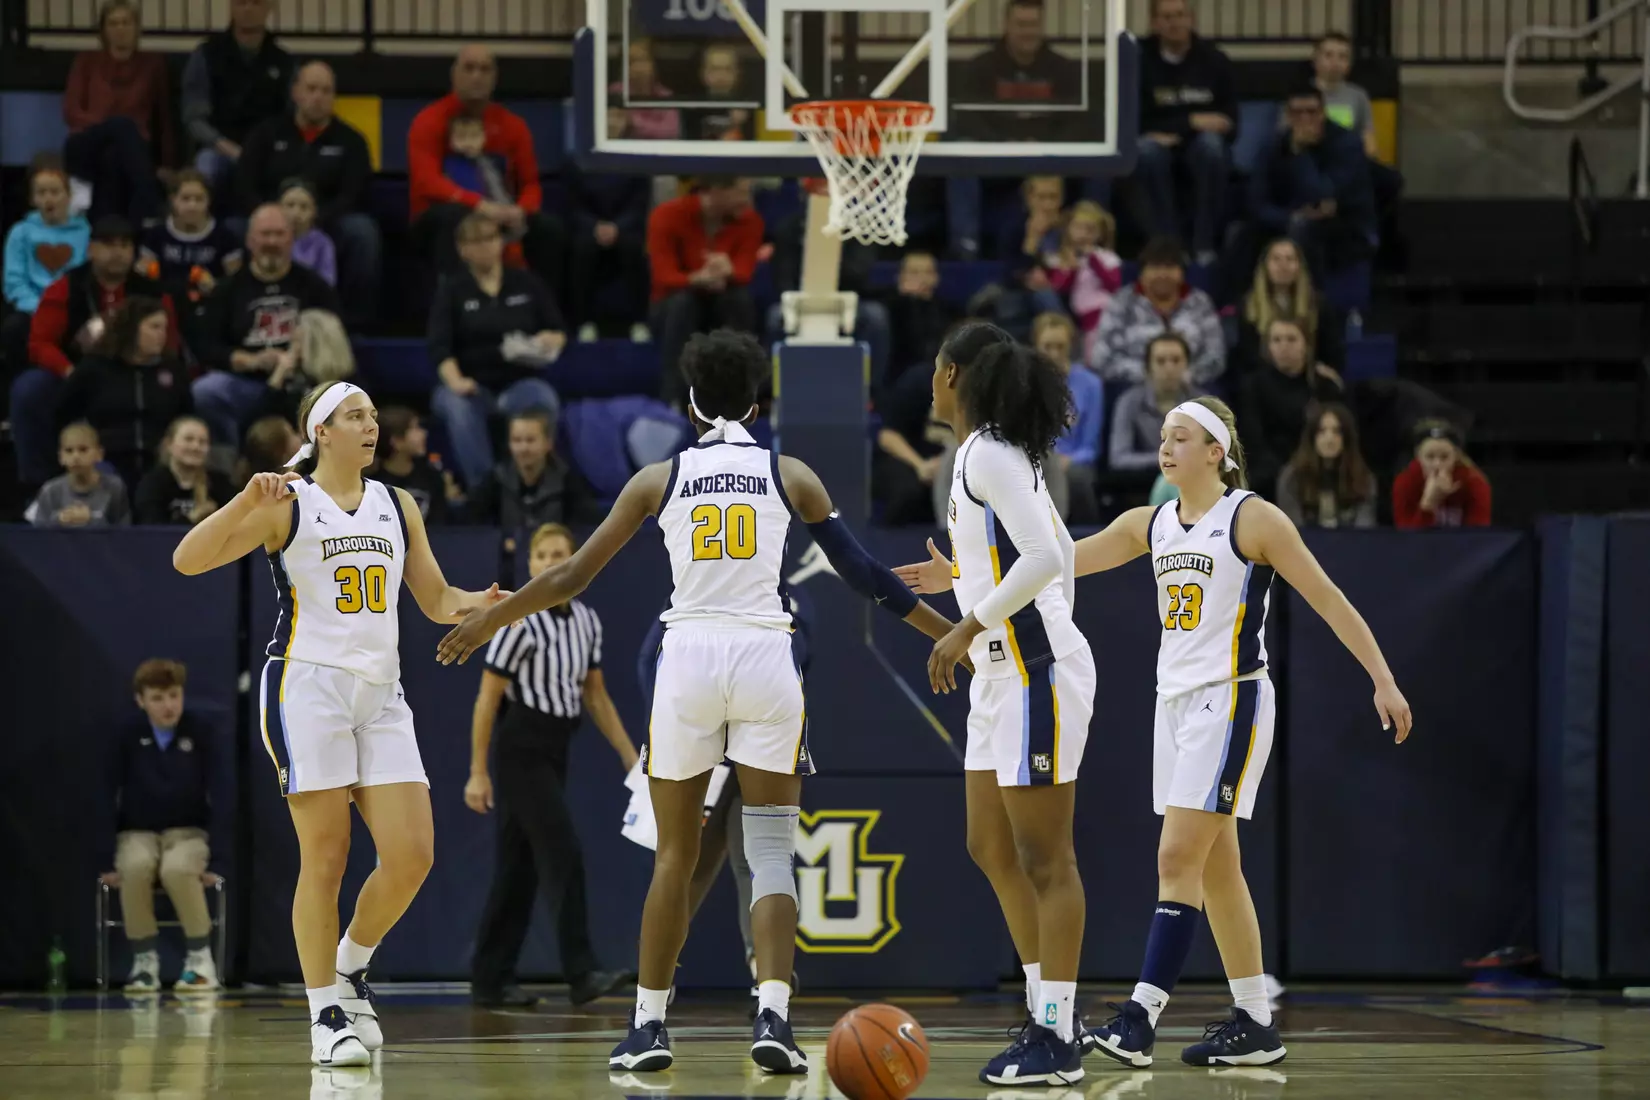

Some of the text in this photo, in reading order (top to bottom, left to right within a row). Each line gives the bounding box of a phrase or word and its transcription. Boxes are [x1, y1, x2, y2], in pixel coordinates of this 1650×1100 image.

[680, 473, 767, 498] ANDERSON
[691, 503, 757, 561] 20
[322, 536, 393, 560] MARQUETTE
[1155, 553, 1213, 579] MARQUETTE
[334, 565, 387, 614] 30
[1165, 583, 1204, 631] 23
[1032, 754, 1050, 771] MU
[1221, 785, 1234, 801] MU
[795, 813, 898, 949] MU
